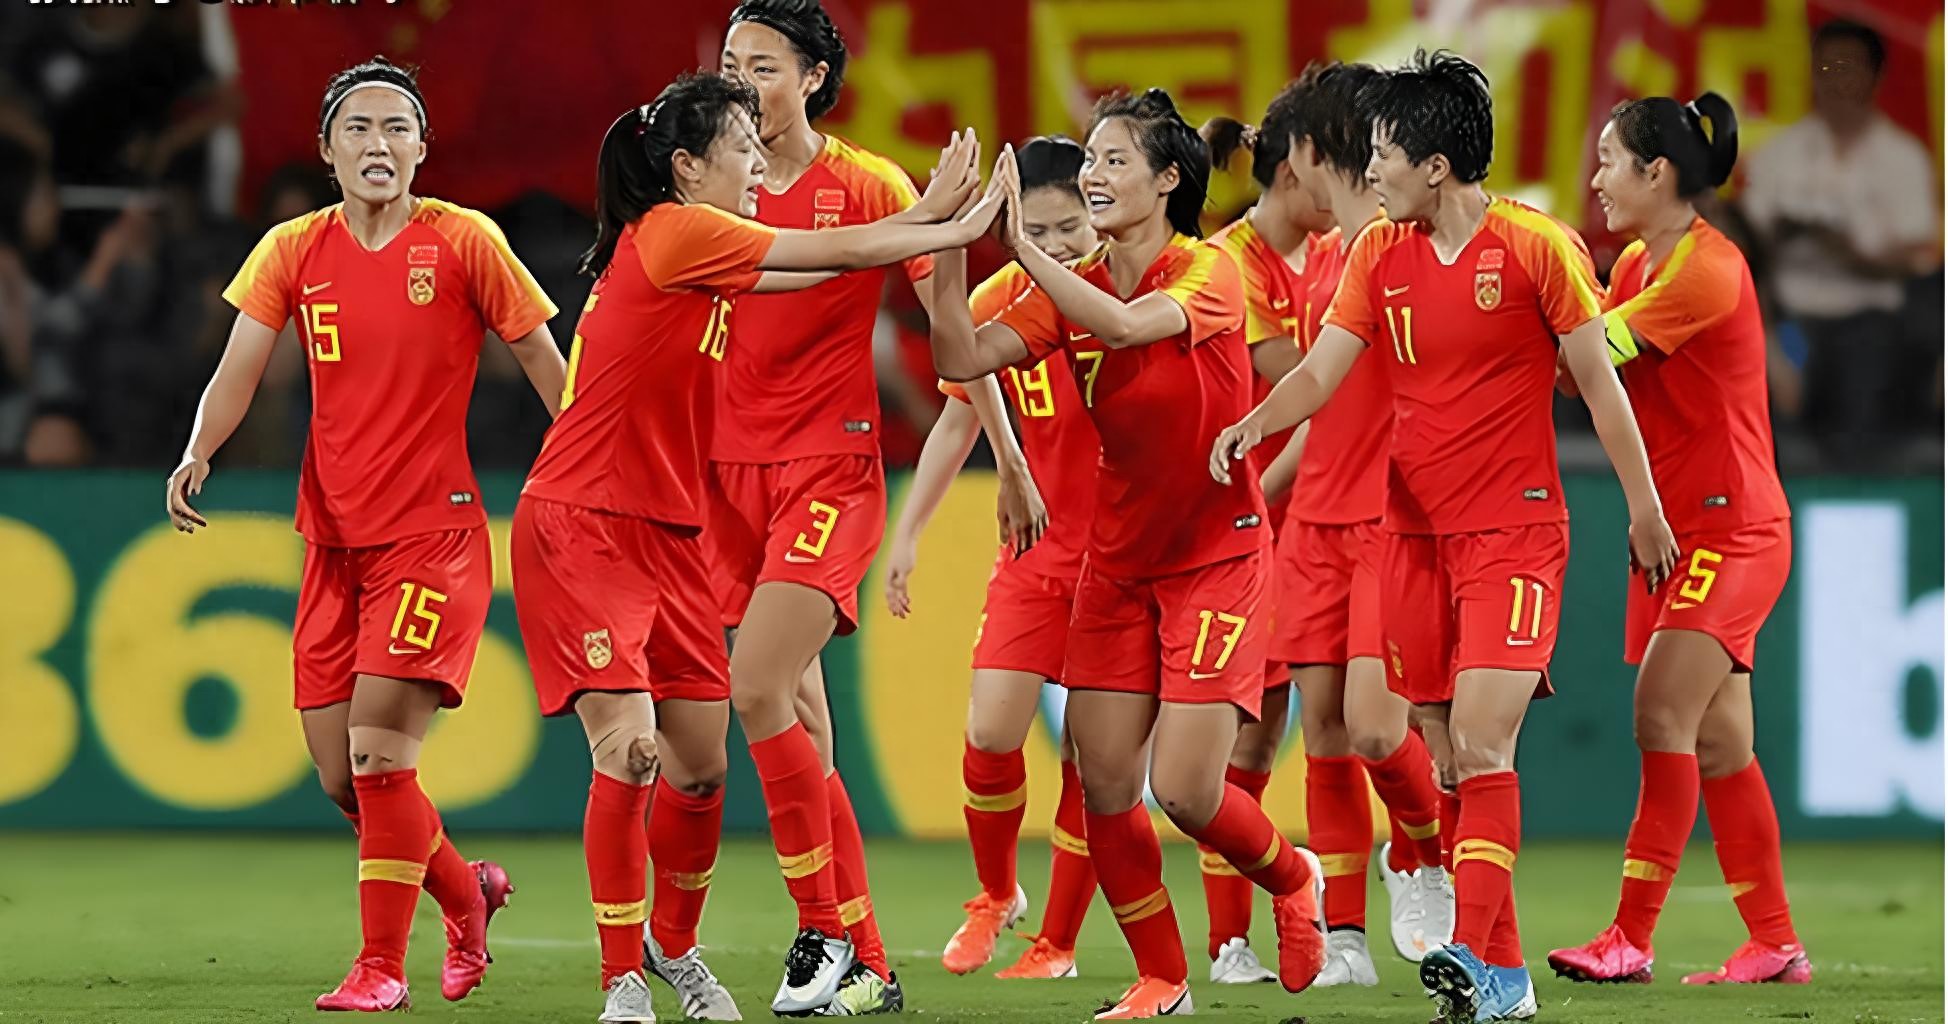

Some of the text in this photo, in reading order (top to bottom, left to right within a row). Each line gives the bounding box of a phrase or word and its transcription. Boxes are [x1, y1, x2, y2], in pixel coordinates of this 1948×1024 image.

[300, 303, 341, 362] 15
[1385, 306, 1416, 364] 11
[1008, 359, 1054, 416] 19
[793, 500, 840, 558] 3
[1679, 548, 1722, 603] 5
[390, 582, 448, 650] 15
[1510, 577, 1543, 639] 11
[1191, 609, 1247, 670] 17
